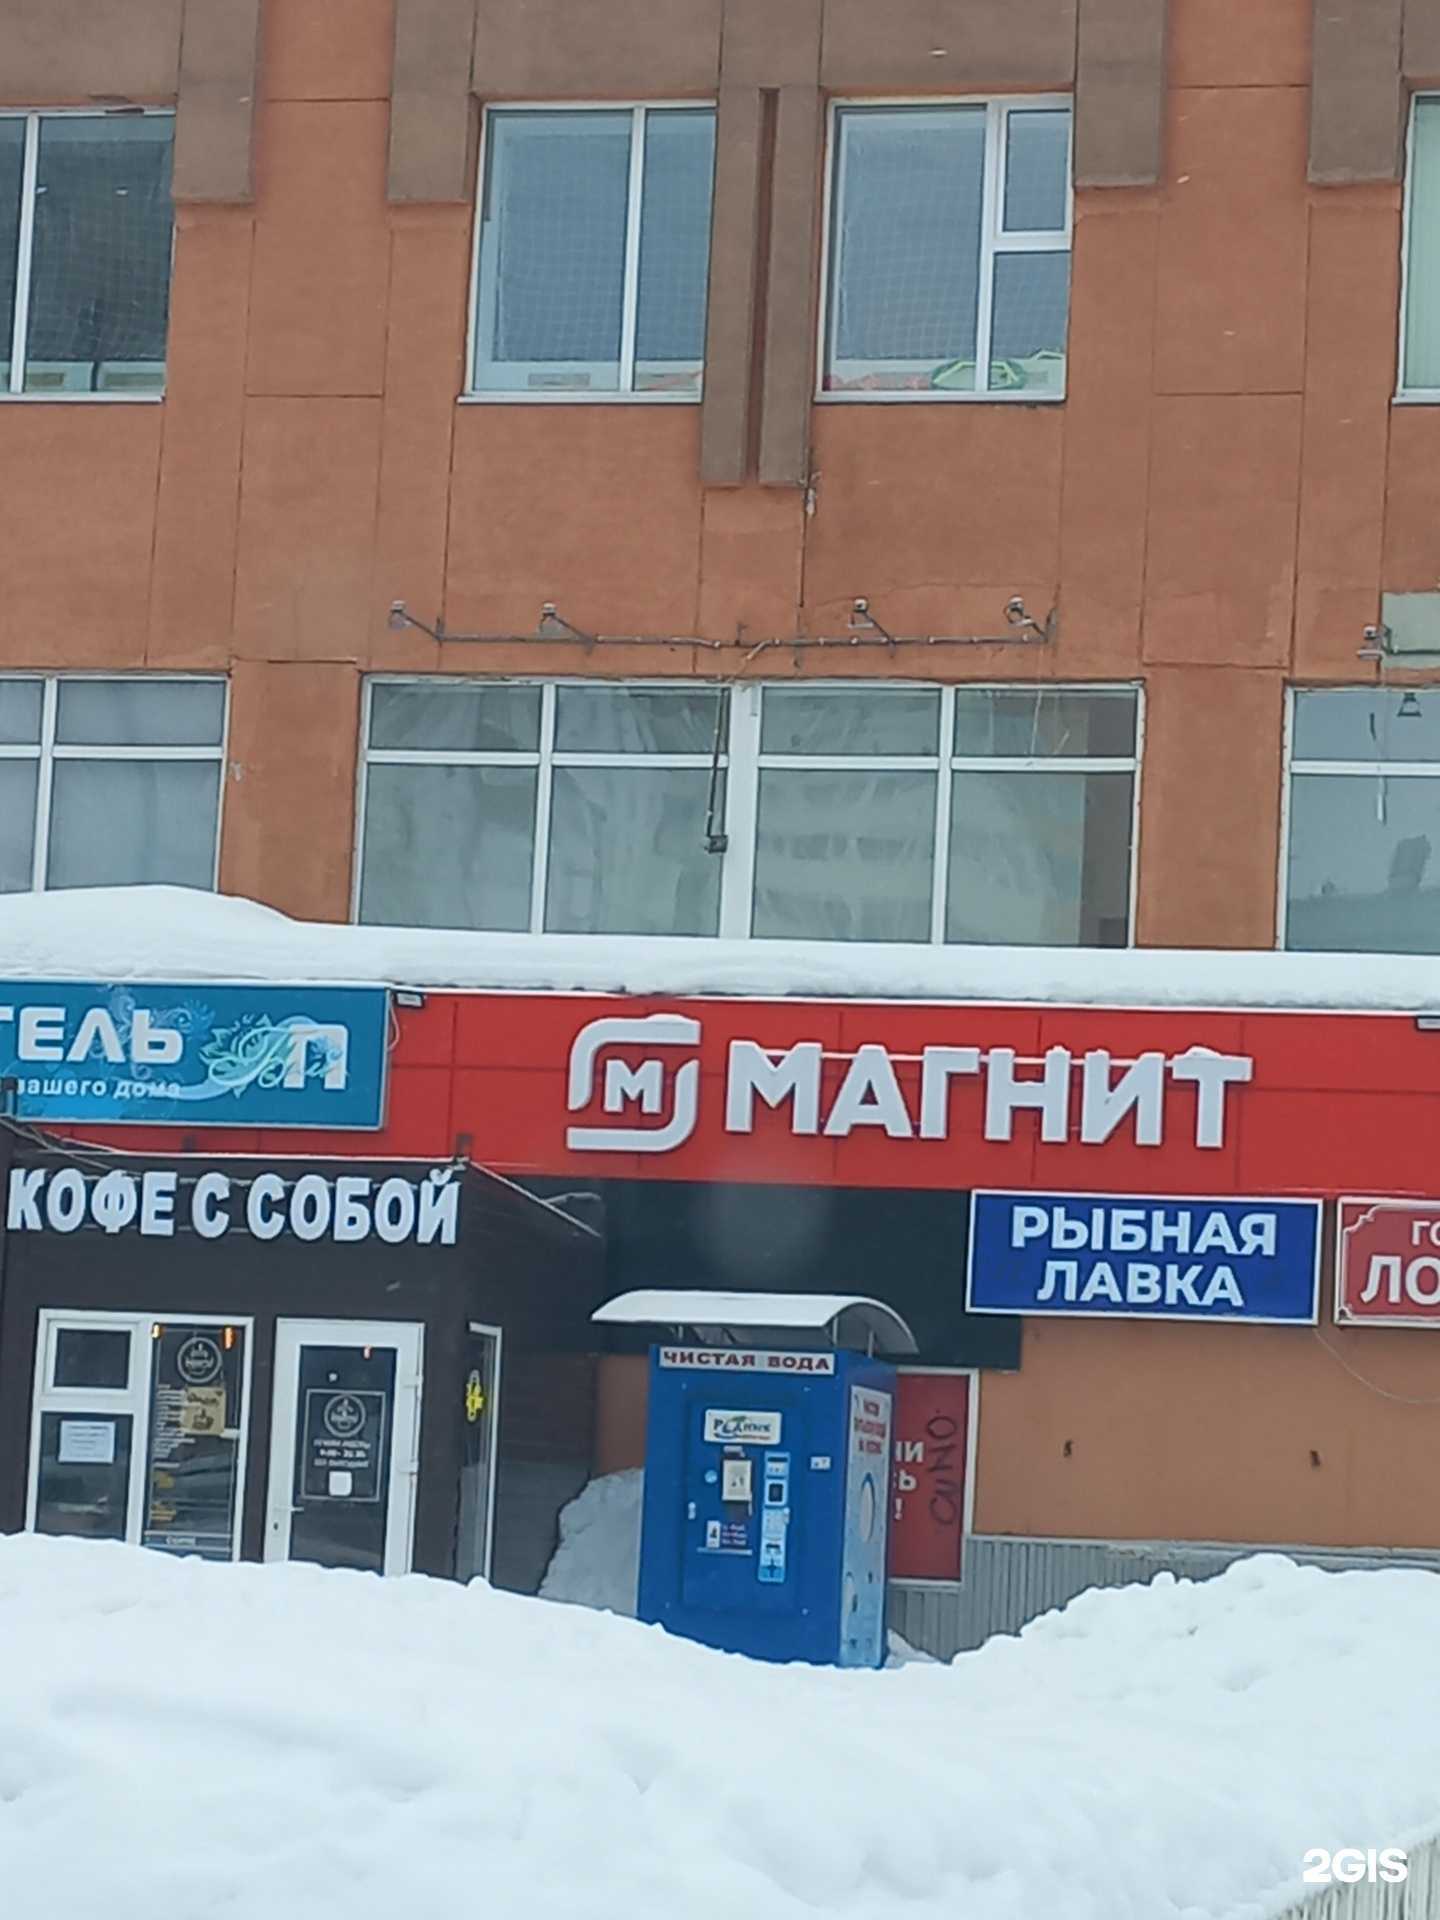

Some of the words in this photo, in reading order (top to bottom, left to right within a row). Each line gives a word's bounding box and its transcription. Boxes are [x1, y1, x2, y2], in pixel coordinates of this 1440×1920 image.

[725, 1040, 1252, 1148] МАГНИТ
[7, 1168, 178, 1237] КОФЕ
[192, 1172, 231, 1238] С
[247, 1167, 461, 1246] СОБОЙ
[1011, 1206, 1278, 1256] РЫБНАЯ
[1036, 1259, 1245, 1308] ЛАВКА
[663, 1350, 756, 1367] ЧИСТАЯ
[767, 1355, 830, 1371] ВОДА
